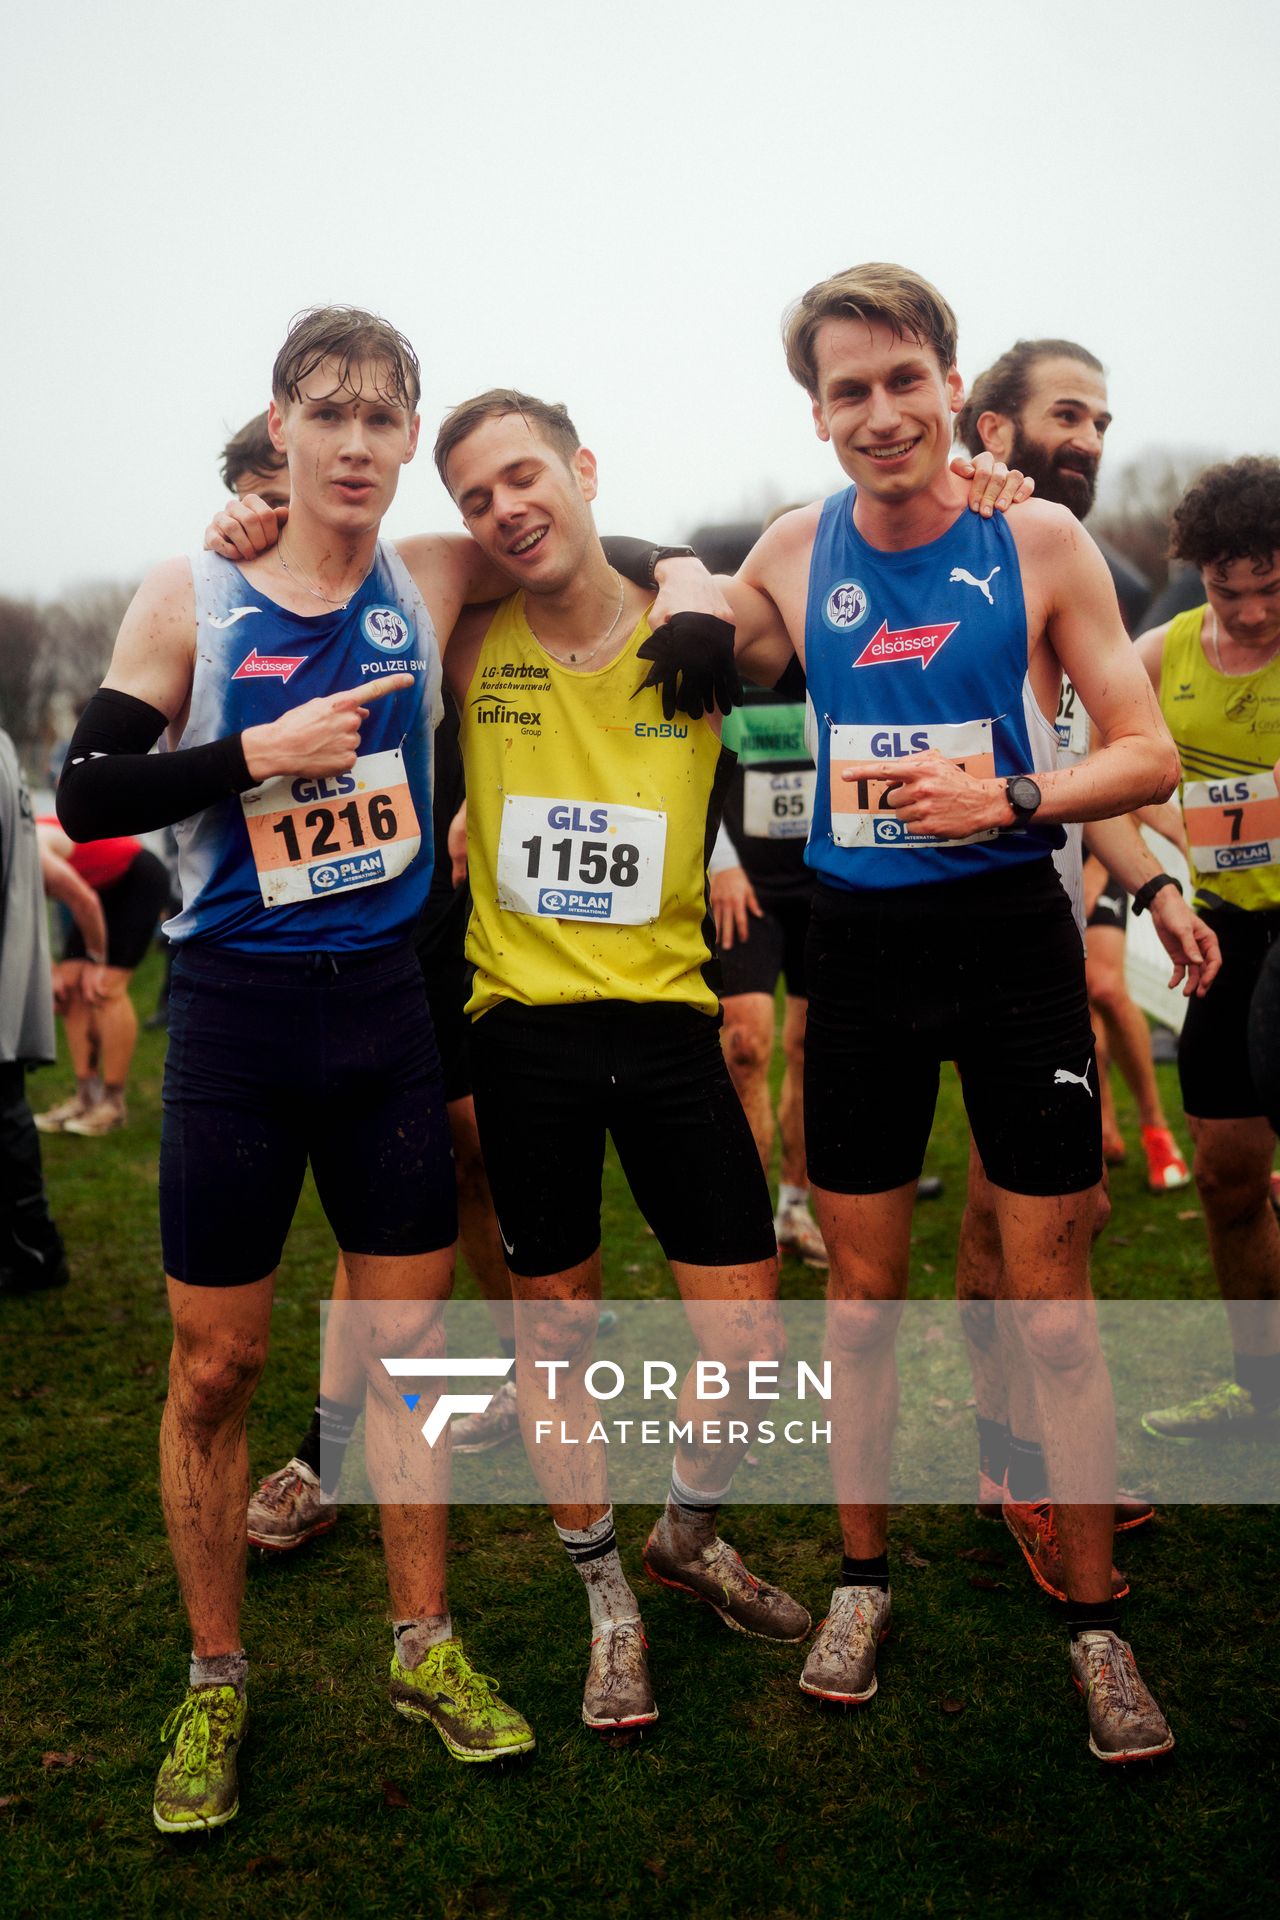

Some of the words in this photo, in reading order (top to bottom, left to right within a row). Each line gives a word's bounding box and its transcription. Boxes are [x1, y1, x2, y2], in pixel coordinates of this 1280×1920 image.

[871, 634, 939, 656] elsässer
[244, 659, 294, 673] elsässer
[360, 660, 408, 675] POLIZEI
[409, 659, 427, 671] BW
[477, 704, 542, 726] infinex
[520, 727, 542, 737] Group
[634, 722, 689, 739] EnBW
[870, 732, 931, 758] GLS
[774, 795, 805, 818] 65
[272, 794, 398, 862] 1216
[1223, 807, 1244, 842] 7
[340, 856, 382, 877] PLAN
[521, 835, 640, 888] 1158
[568, 894, 609, 910] PLAN
